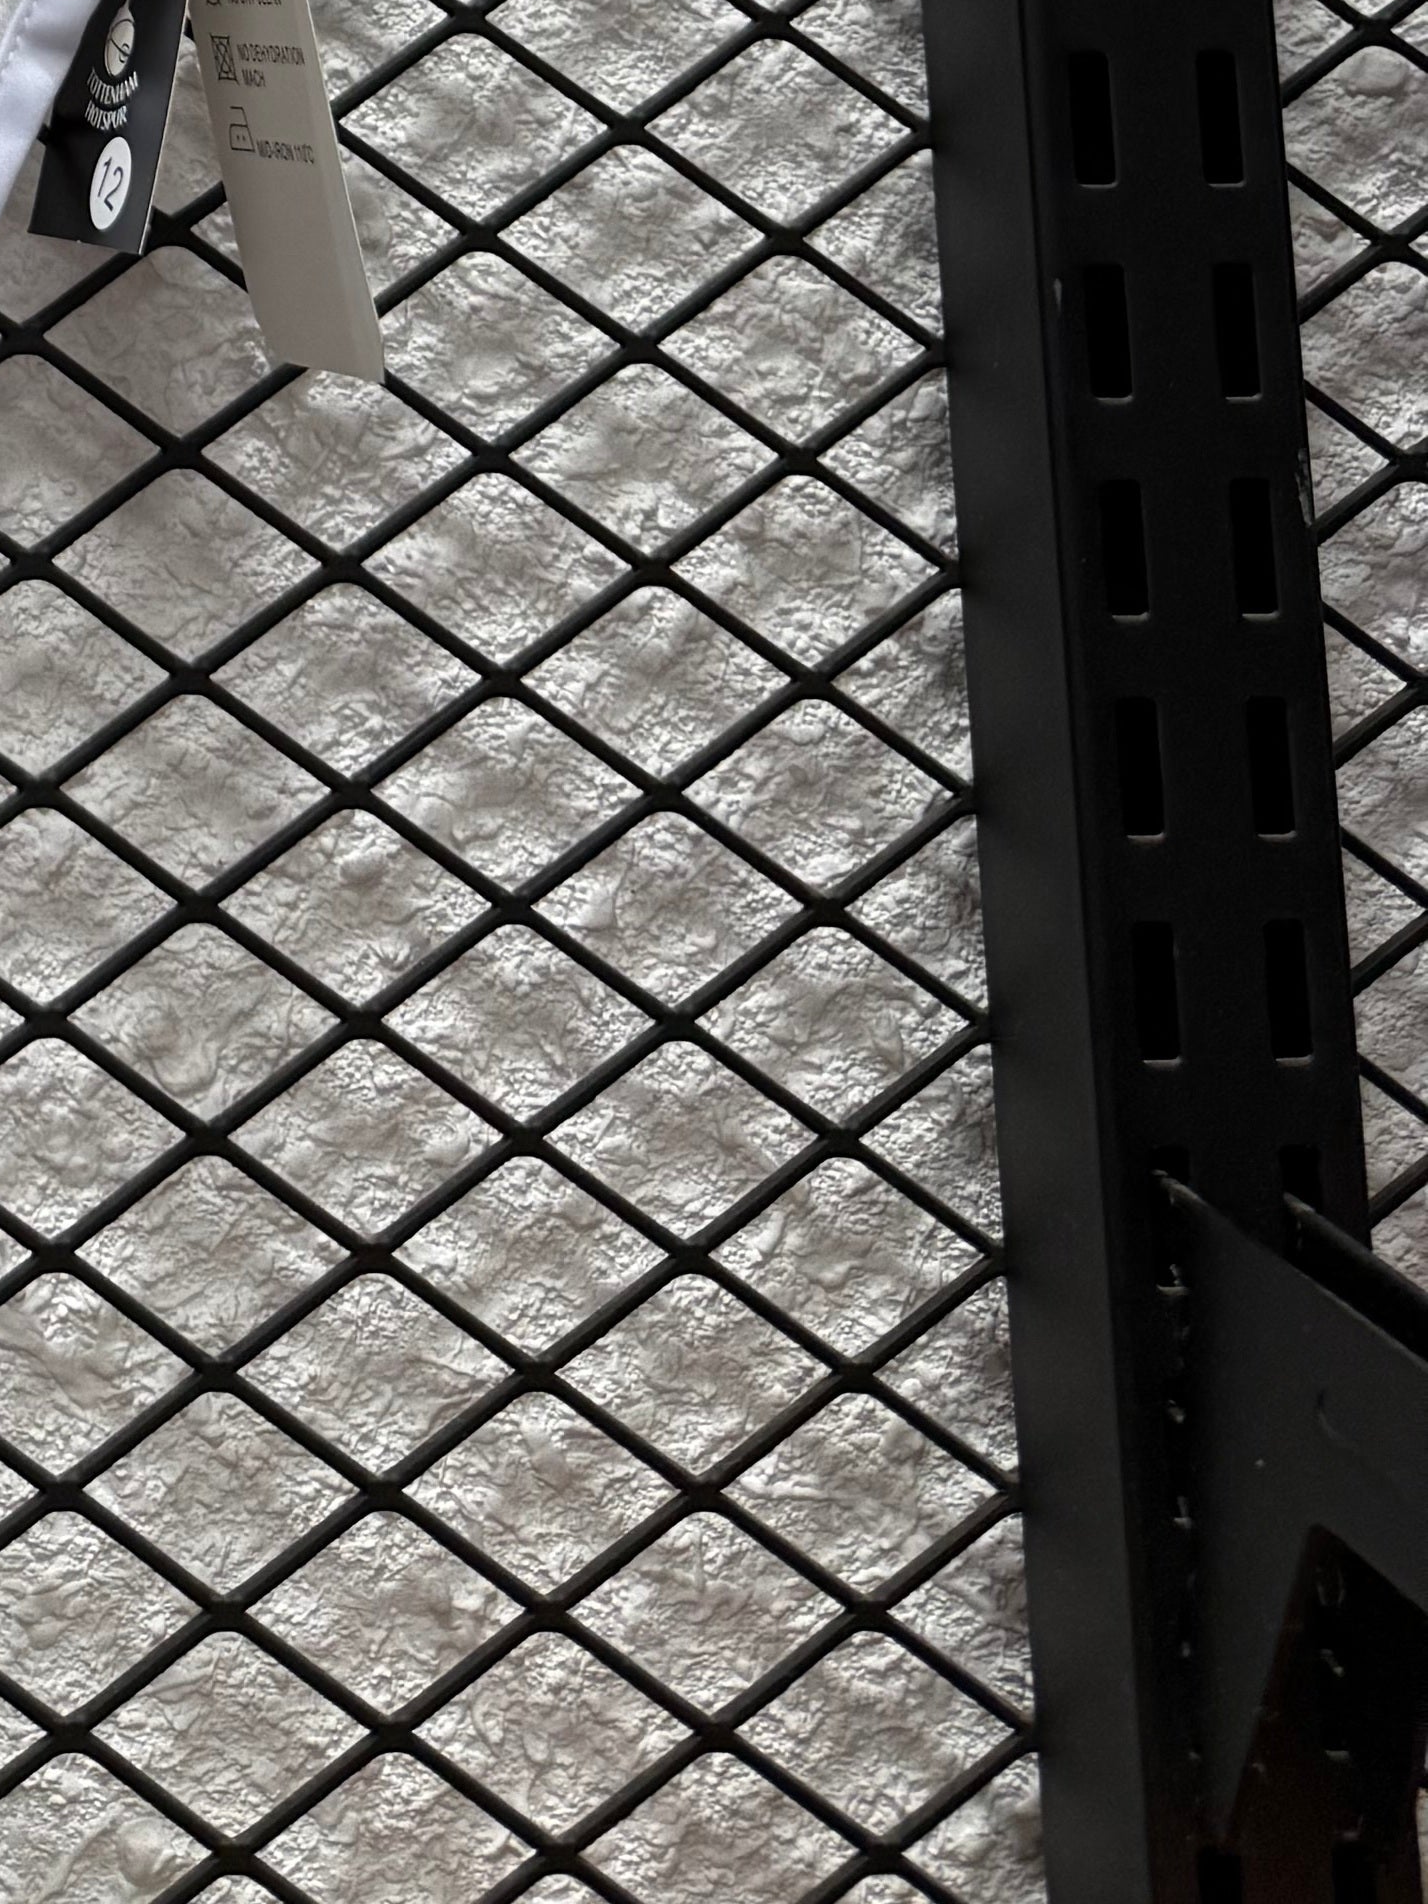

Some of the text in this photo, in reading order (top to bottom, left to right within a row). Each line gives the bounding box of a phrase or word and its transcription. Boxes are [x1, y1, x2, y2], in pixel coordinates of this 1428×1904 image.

[86, 66, 139, 105] TOTTENHAM
[84, 99, 128, 131] HOTSPUR
[97, 155, 124, 212] 12
